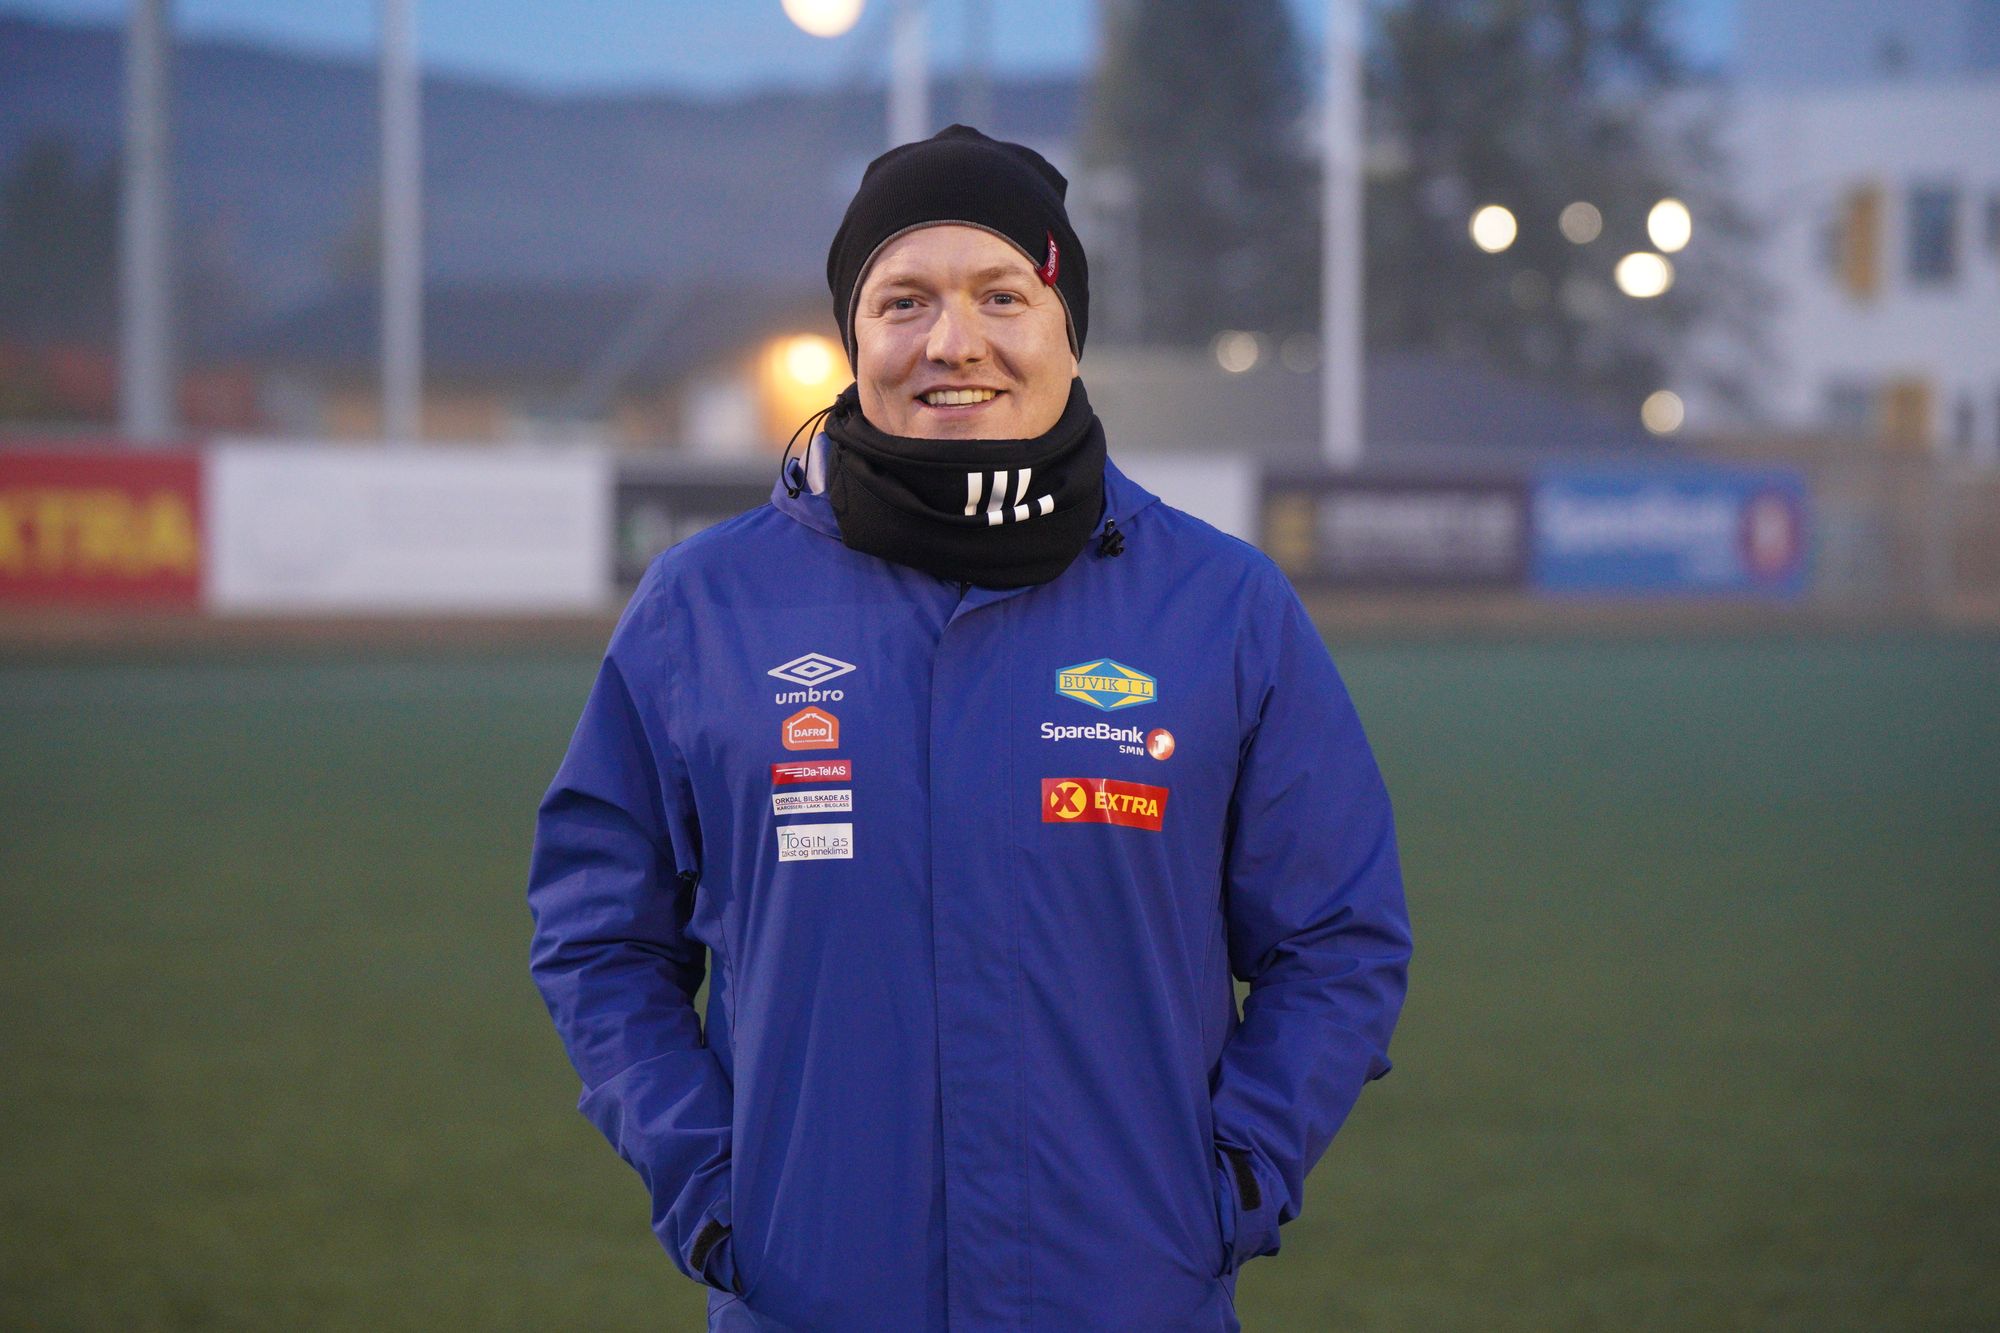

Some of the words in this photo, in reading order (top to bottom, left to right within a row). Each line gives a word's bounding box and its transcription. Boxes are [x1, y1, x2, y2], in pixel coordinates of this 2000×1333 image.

[1063, 675, 1120, 691] BUVIK
[775, 687, 844, 705] umbro
[1040, 722, 1144, 744] SpareBank
[1119, 744, 1144, 756] SMN
[775, 796, 801, 804] ORKDAL
[1094, 791, 1159, 818] EXTRA
[832, 837, 849, 847] as
[782, 849, 797, 857] takst
[798, 850, 809, 858] og
[811, 847, 849, 855] inneklima
